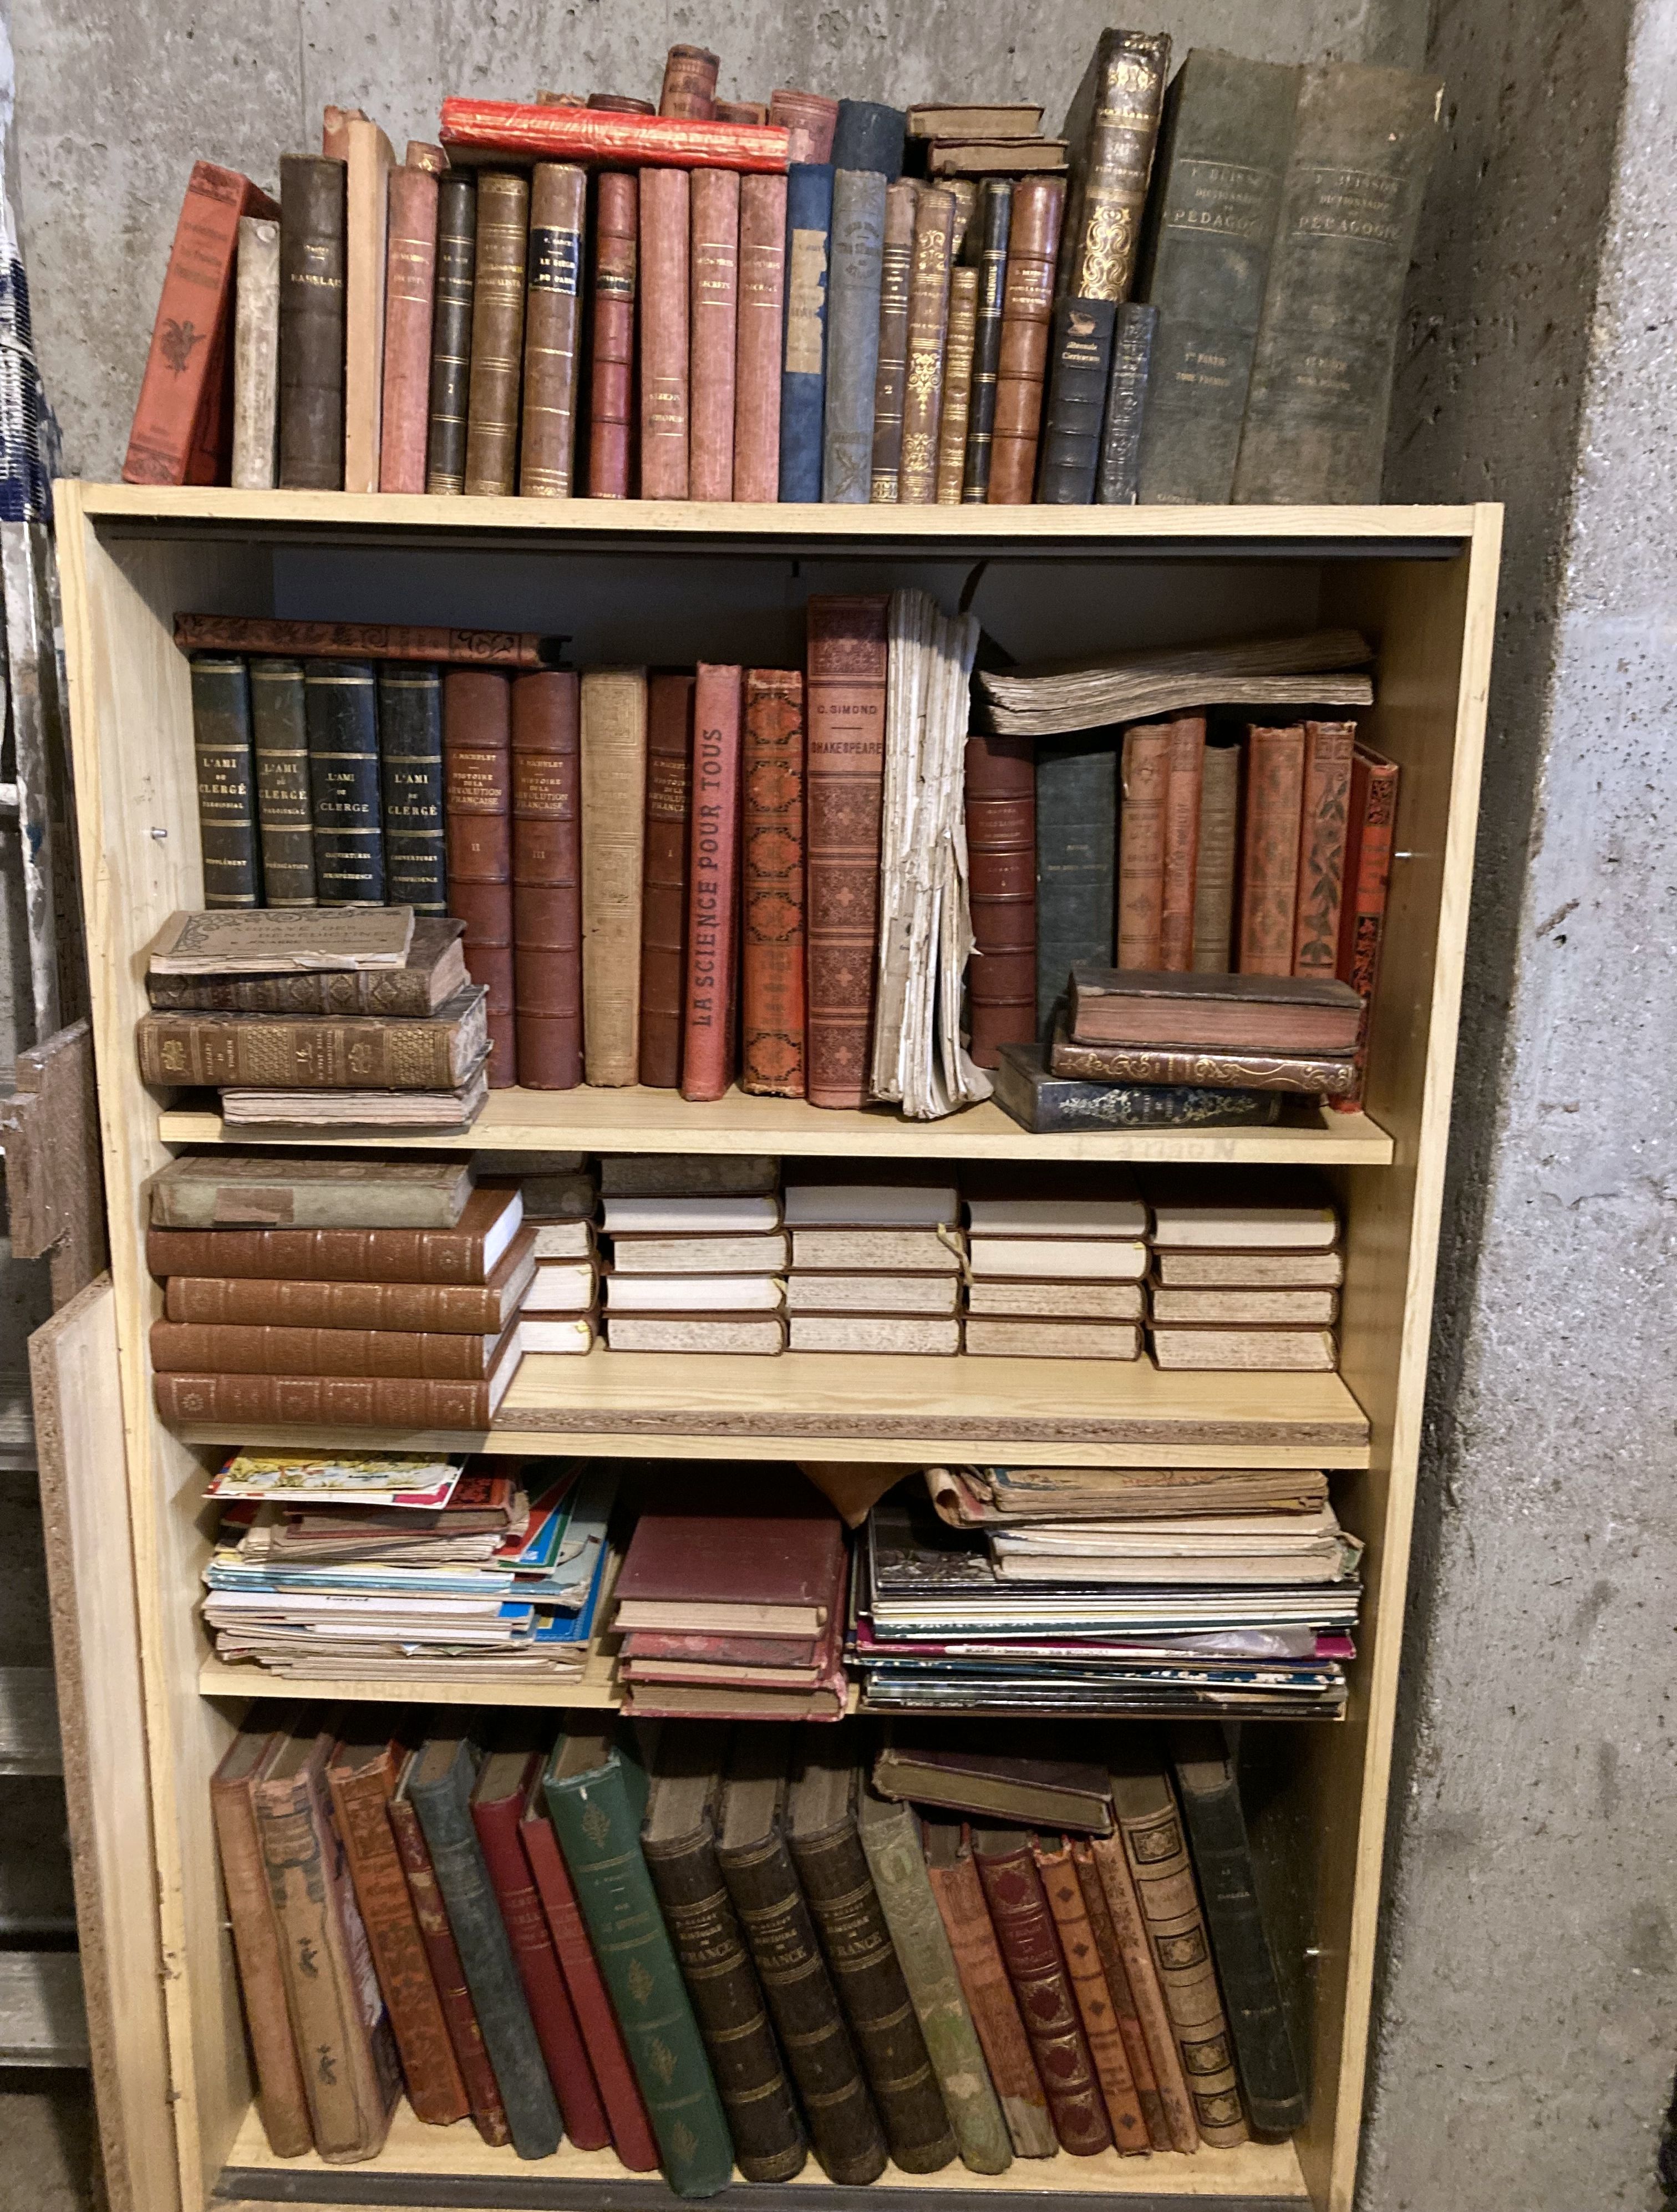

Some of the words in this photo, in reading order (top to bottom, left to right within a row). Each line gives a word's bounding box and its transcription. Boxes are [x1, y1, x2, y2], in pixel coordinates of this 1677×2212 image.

[811, 742, 883, 754] SHAKESPEARE
[203, 757, 237, 769] L'AMI
[701, 728, 722, 791] TOUS
[264, 764, 298, 774] L'AMI
[327, 773, 355, 782] L'AMI
[394, 774, 429, 784] L'AMI
[698, 804, 721, 869] POUR
[695, 881, 720, 986] SCIENCE
[693, 998, 712, 1026] LA
